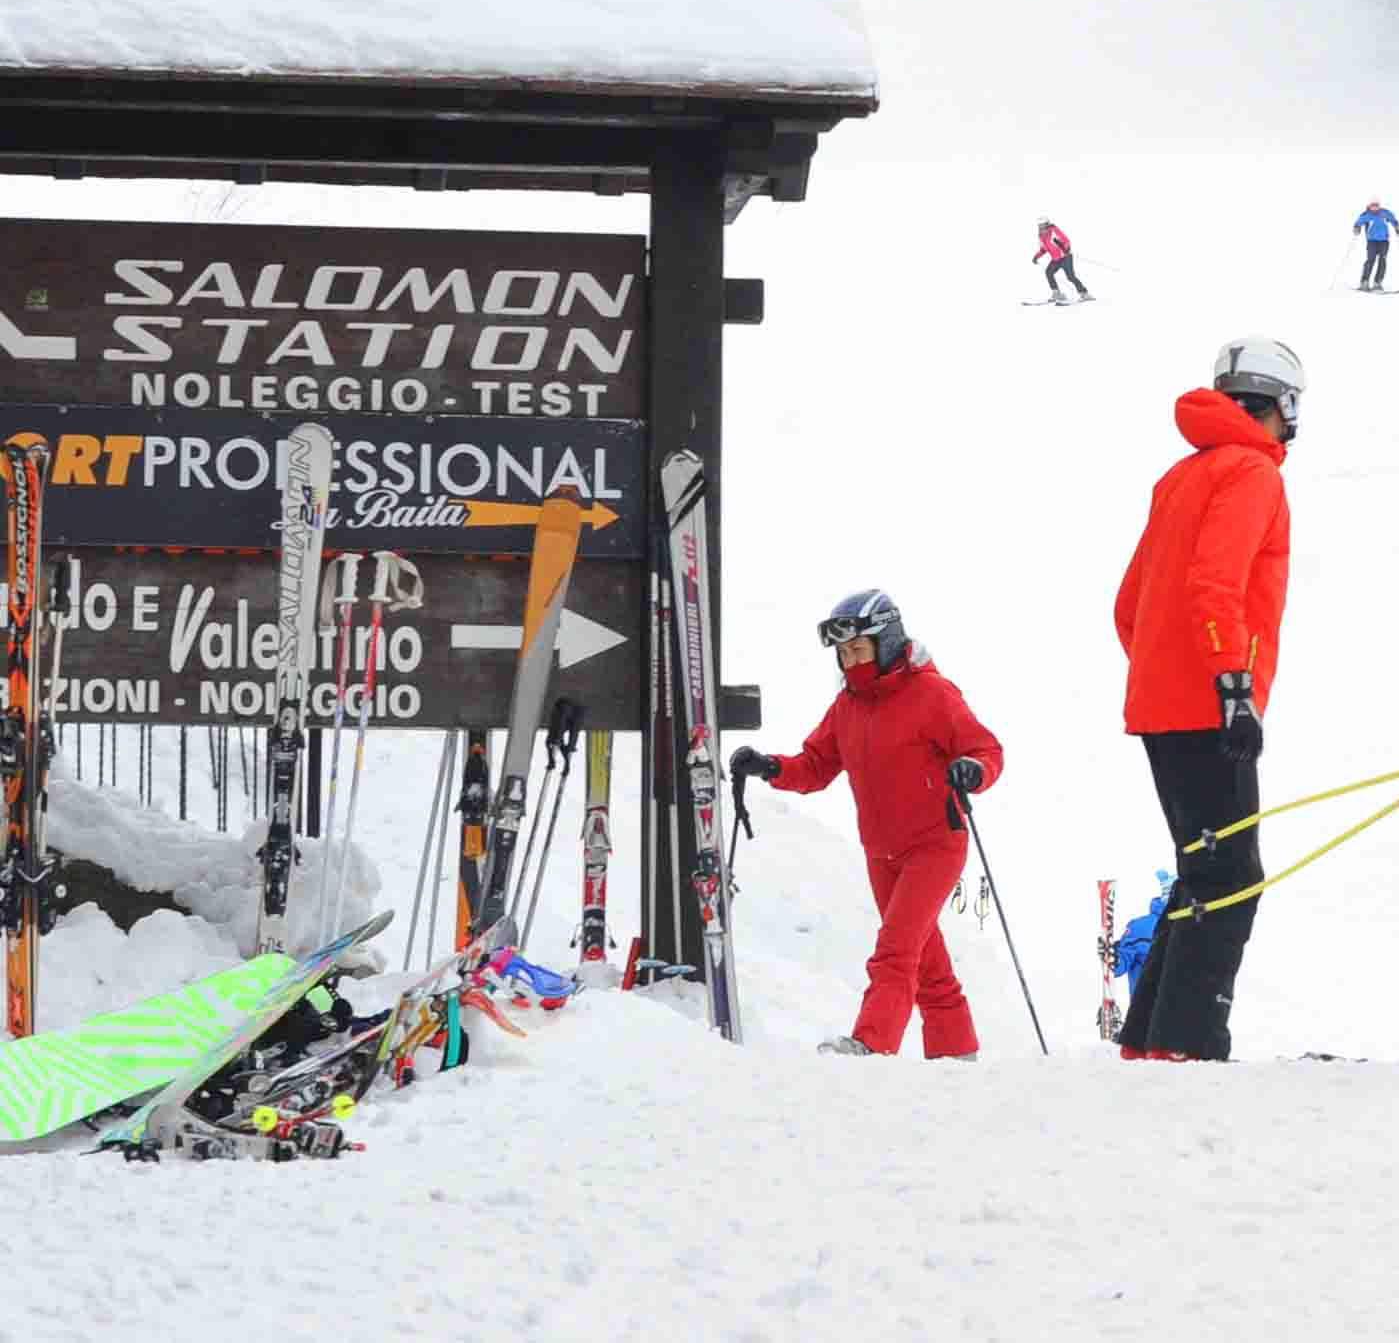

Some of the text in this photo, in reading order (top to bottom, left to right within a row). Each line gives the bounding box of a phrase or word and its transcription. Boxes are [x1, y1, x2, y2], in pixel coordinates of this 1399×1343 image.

[104, 259, 634, 318] SALOMON
[103, 315, 633, 374] STATION
[131, 372, 428, 413] NOLEGGIO
[471, 381, 608, 417] TEST
[15, 455, 29, 595] ROSSIGNOL
[346, 490, 468, 530] Baita
[132, 585, 160, 631] E
